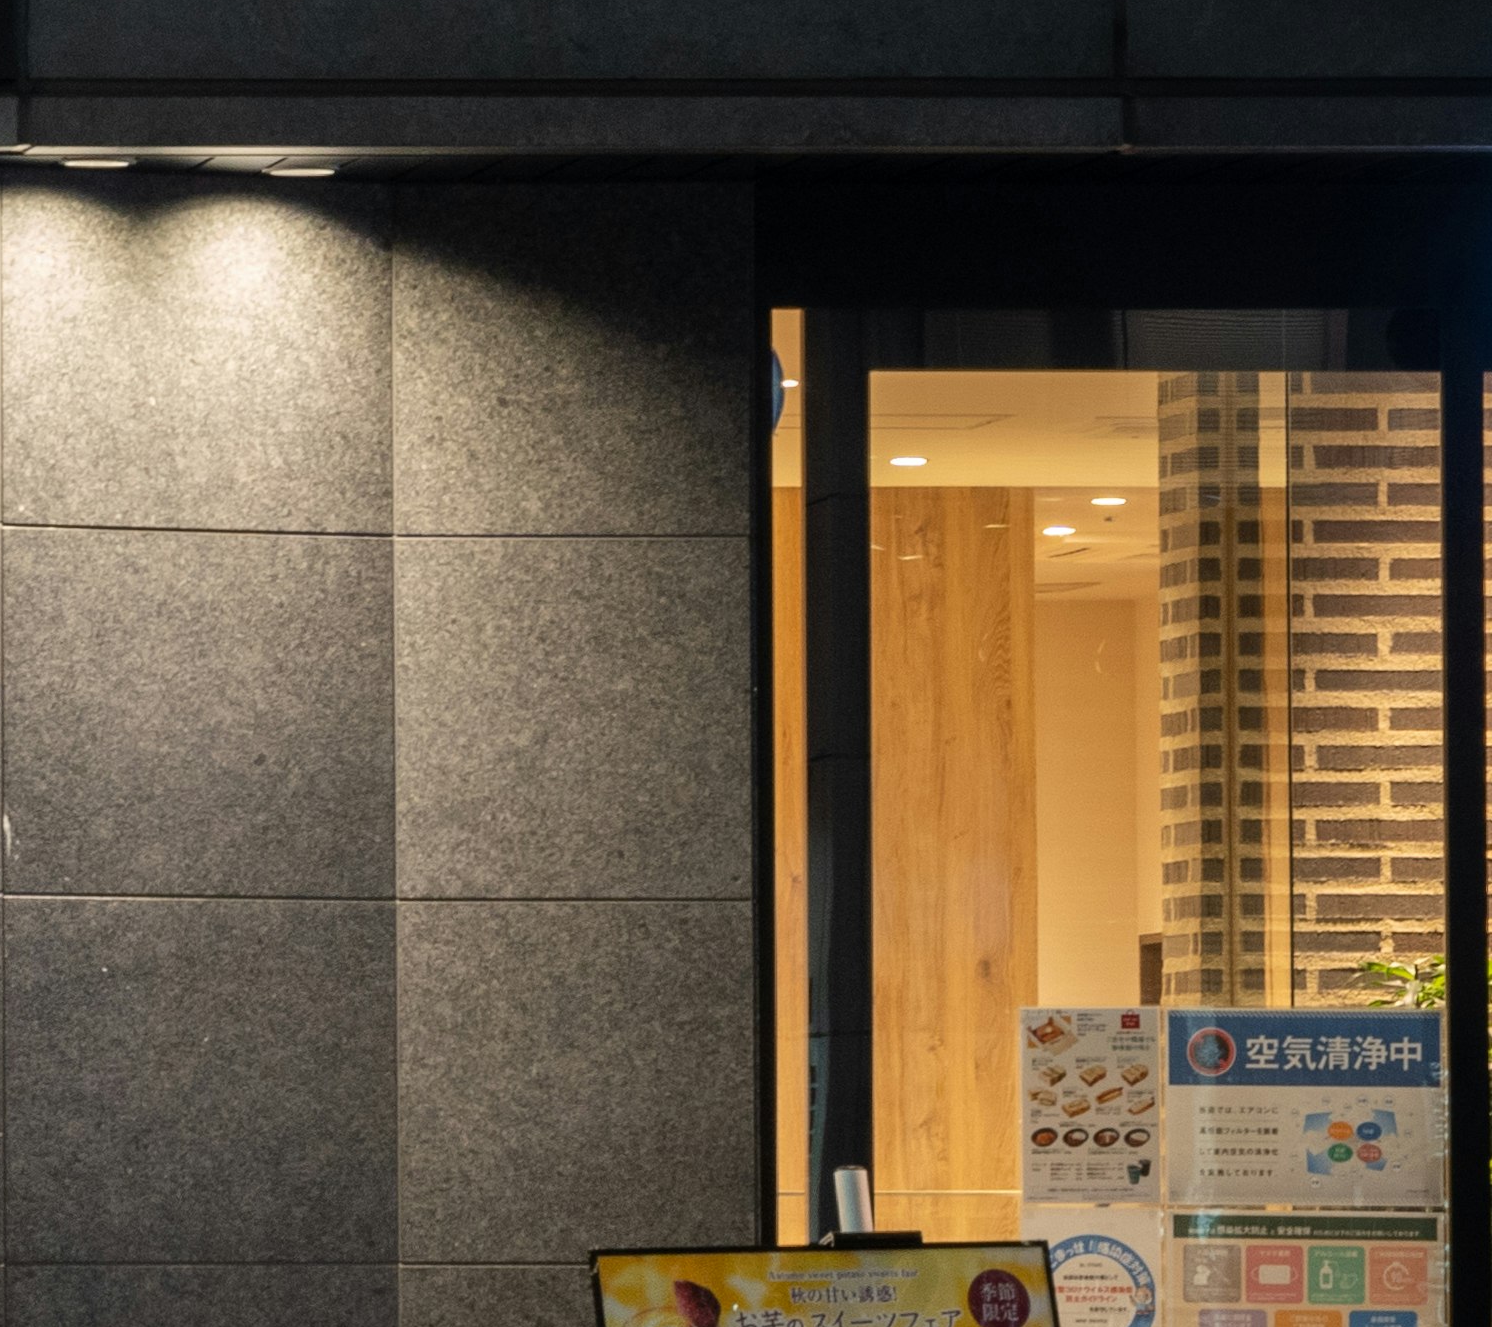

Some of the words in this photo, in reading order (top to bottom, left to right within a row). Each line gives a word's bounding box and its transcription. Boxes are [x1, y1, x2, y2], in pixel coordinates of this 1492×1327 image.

[1246, 1034, 1423, 1071] 空気清浄中
[980, 1282, 1016, 1301] 季節
[981, 1302, 1020, 1323] 限定
